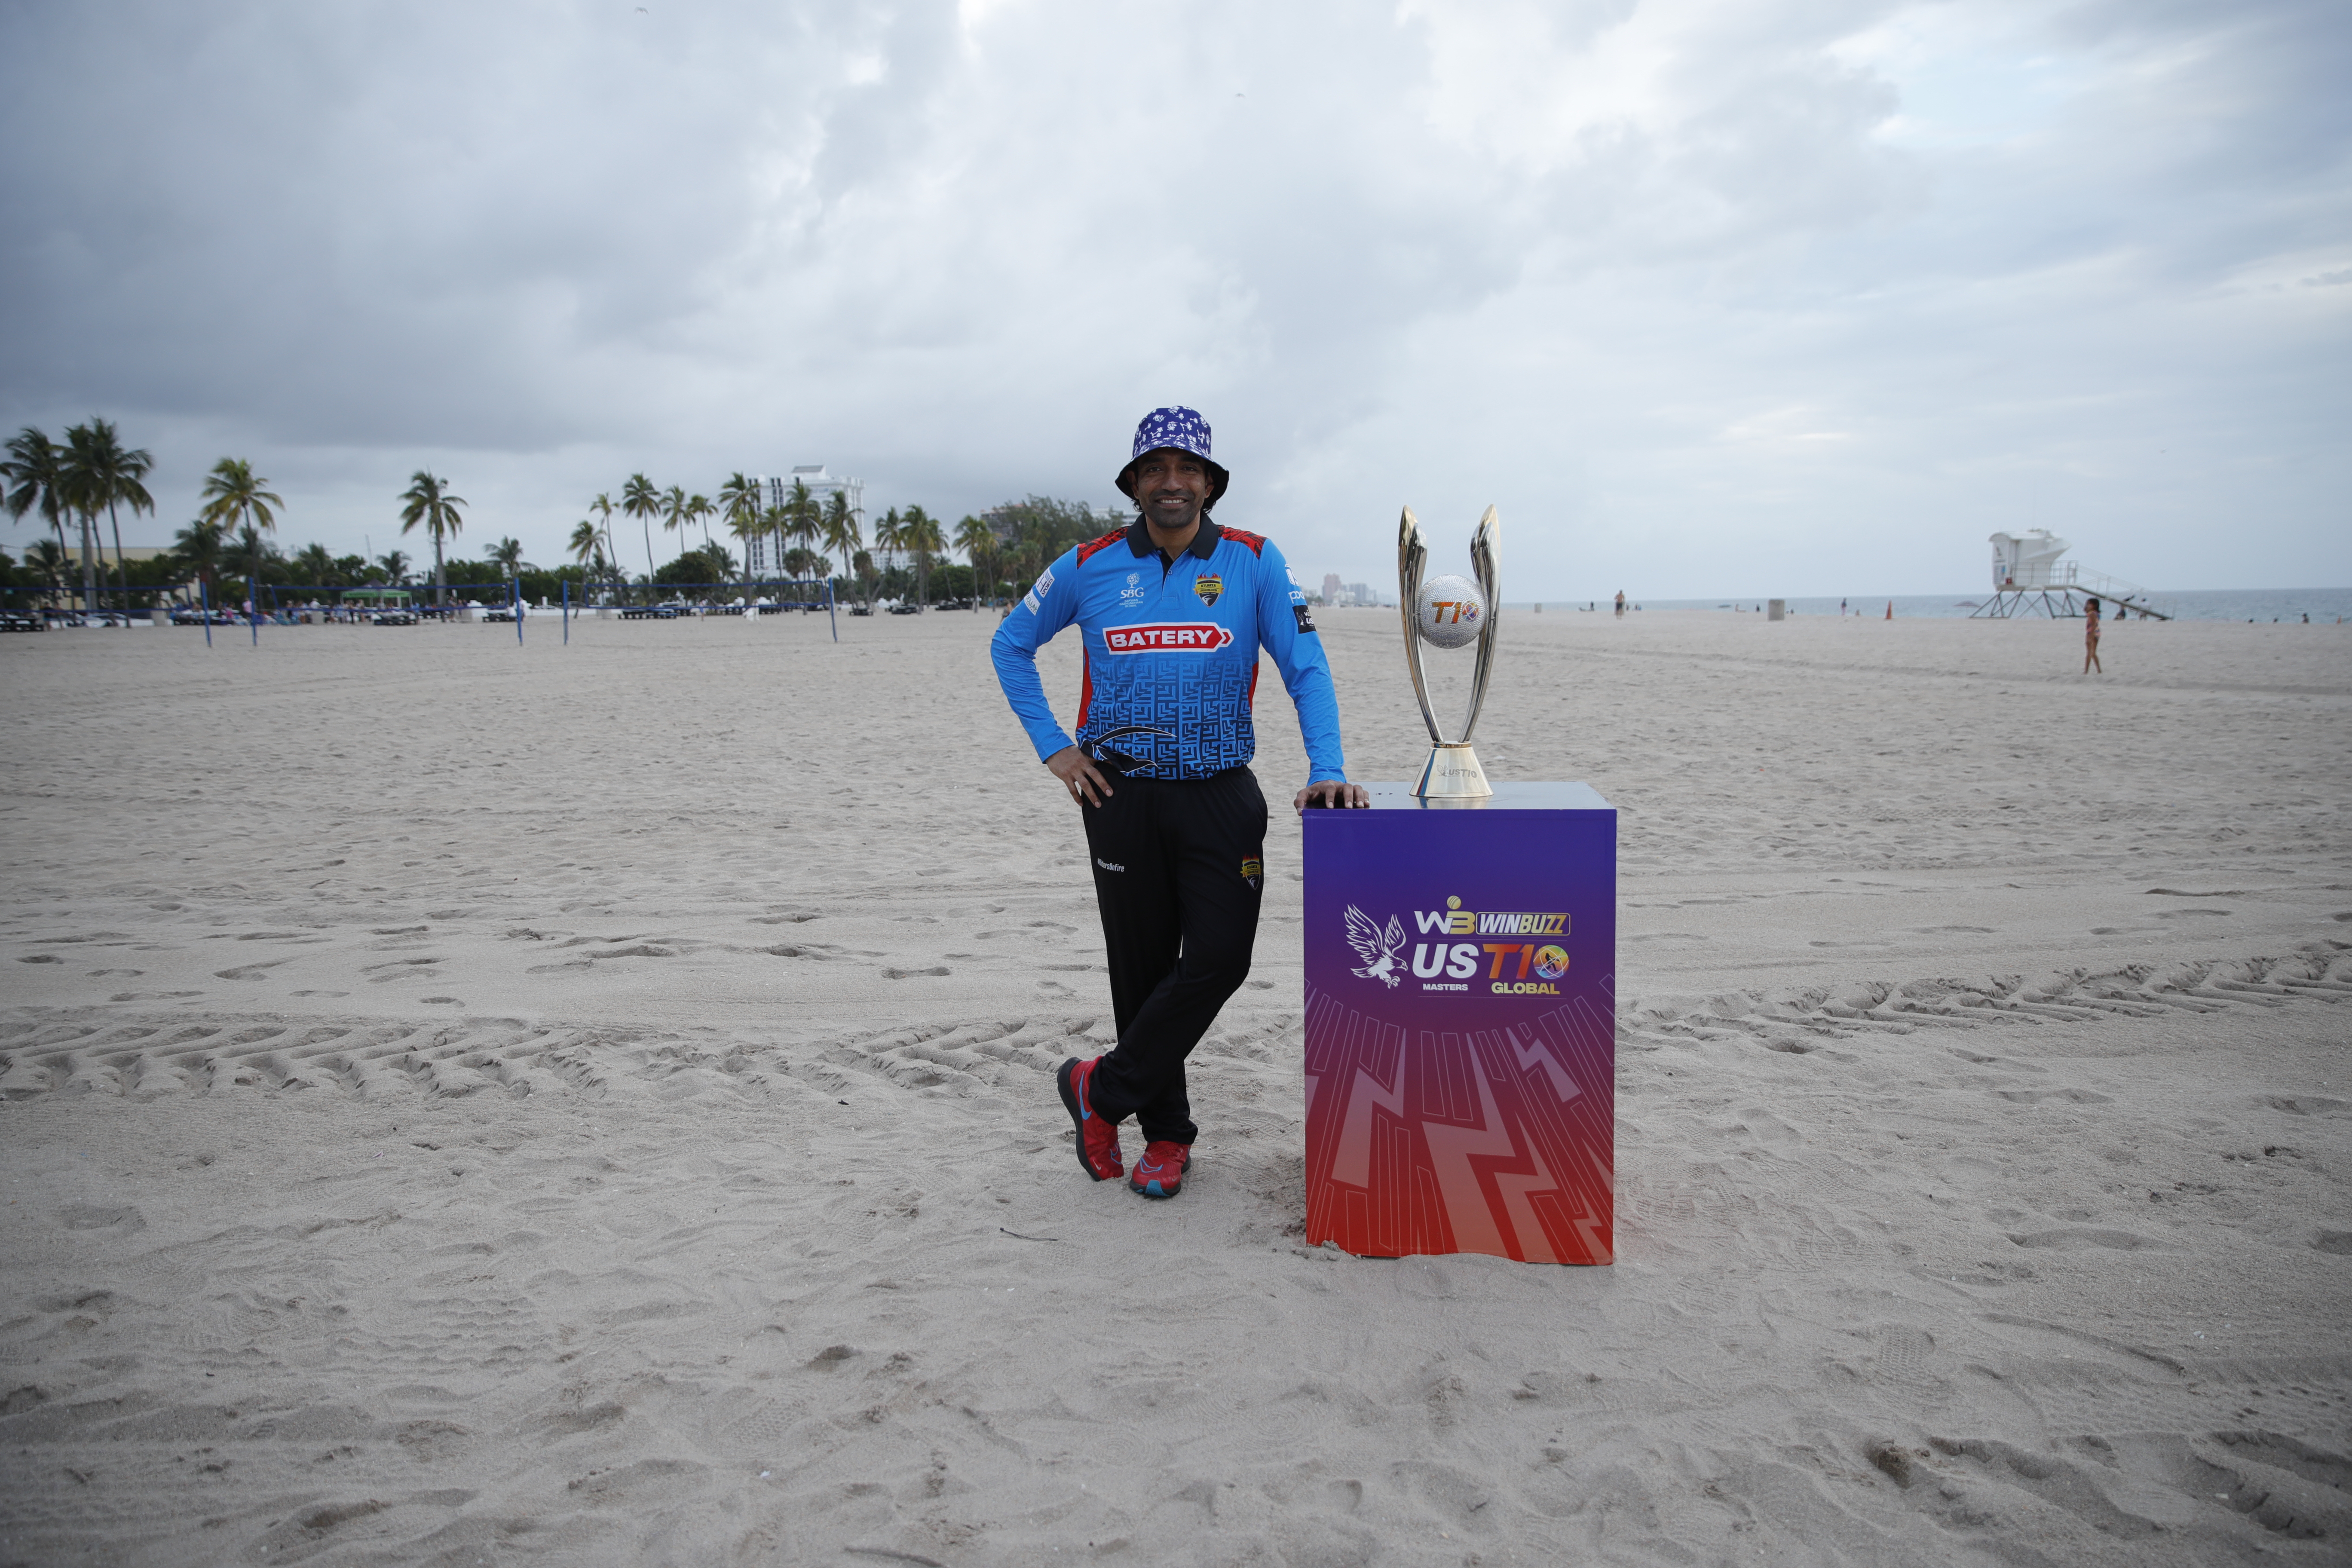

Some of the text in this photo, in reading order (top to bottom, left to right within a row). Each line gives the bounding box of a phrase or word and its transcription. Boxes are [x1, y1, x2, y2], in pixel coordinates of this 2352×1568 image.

[1042, 579, 1053, 596] SPORTS
[1120, 587, 1144, 598] SBG
[1026, 594, 1038, 611] DOLLAR
[1111, 630, 1213, 647] BATERY
[1479, 914, 1567, 934] WINBUZZ
[1412, 943, 1479, 979] US
[1491, 982, 1560, 994] GLOBAL
